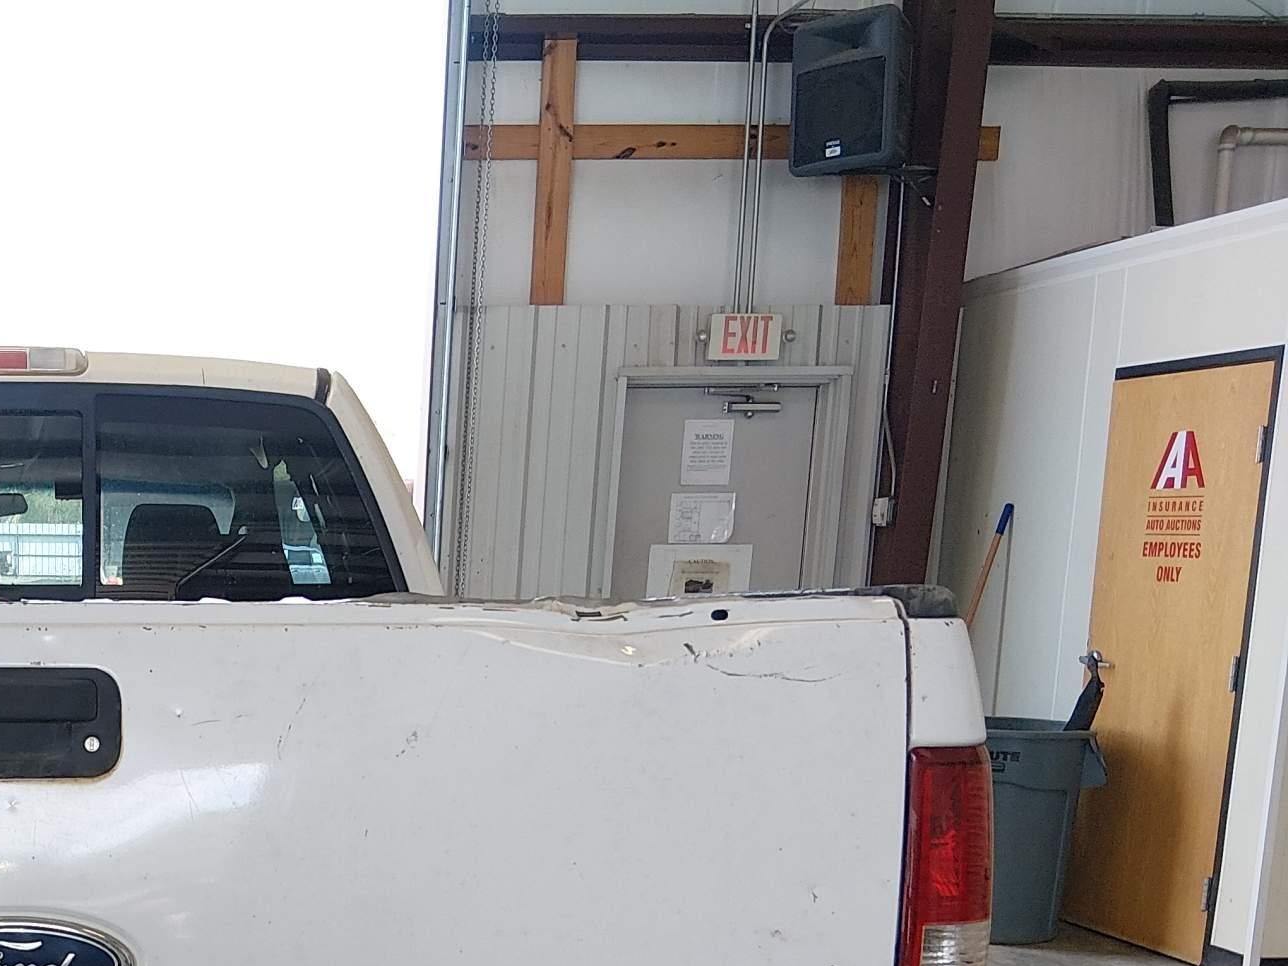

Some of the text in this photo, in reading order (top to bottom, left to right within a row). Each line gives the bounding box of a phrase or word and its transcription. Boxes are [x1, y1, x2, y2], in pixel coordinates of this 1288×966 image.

[721, 315, 774, 354] EXIT
[1147, 500, 1204, 513] INSURANCE
[1146, 519, 1201, 531] AUTO AUCTIONS
[1142, 541, 1202, 559] EMPLOYEES
[1156, 566, 1182, 583] ONLY
